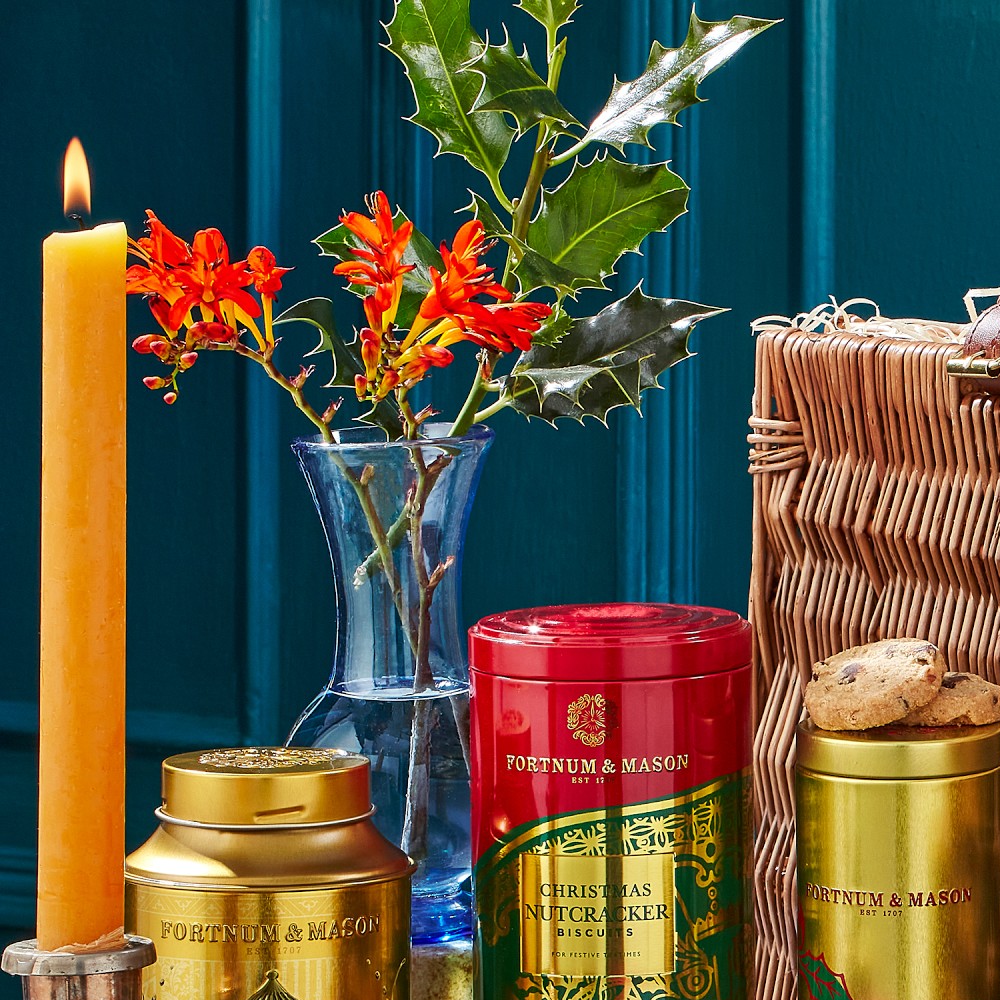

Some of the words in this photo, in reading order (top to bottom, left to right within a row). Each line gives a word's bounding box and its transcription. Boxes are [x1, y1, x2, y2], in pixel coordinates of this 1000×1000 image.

[506, 754, 597, 775] FORTNUM
[601, 758, 616, 774] &
[621, 754, 689, 774] MASON
[571, 776, 590, 784] EST
[540, 883, 652, 898] CHRISTMAS
[806, 883, 885, 908] FORTNUM
[889, 892, 903, 908] &
[908, 887, 972, 908] MASON
[525, 903, 670, 923] NUTCRACKER
[160, 919, 281, 943] FORTNUM
[285, 923, 303, 942] &
[307, 914, 380, 940] MASON
[557, 928, 633, 938] BISCUITS
[246, 947, 269, 956] EST
[276, 946, 301, 955] 1707
